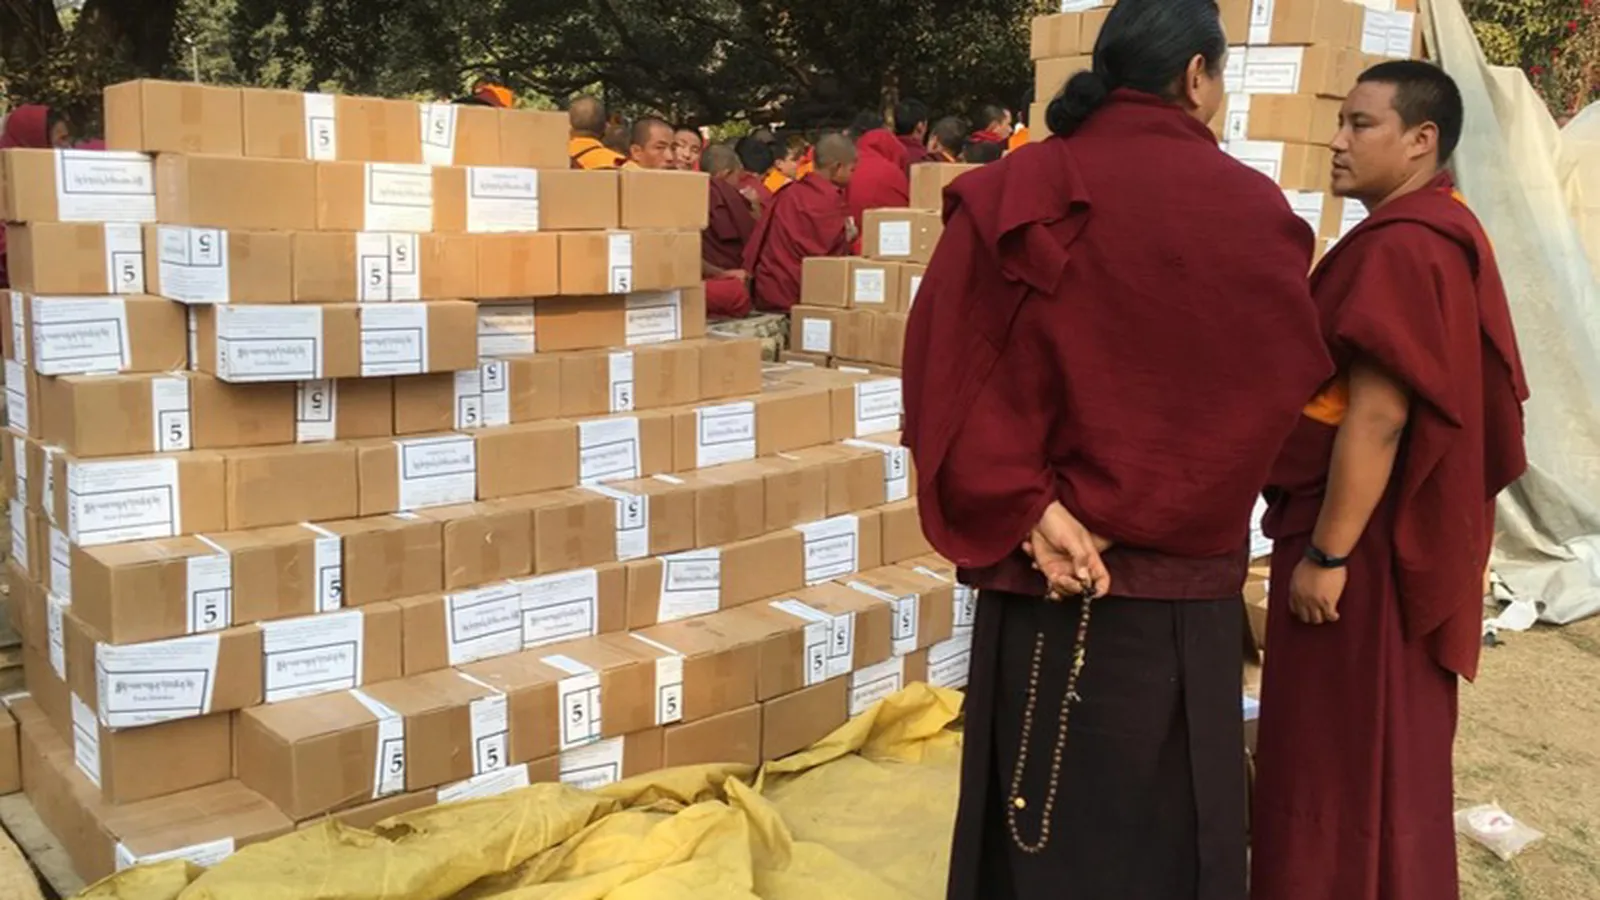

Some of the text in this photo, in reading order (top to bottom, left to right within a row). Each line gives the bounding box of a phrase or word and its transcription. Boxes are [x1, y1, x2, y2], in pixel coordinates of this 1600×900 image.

[435, 119, 445, 135] 5
[319, 130, 330, 145] 5
[198, 234, 211, 253] 5
[396, 246, 406, 262] 5
[123, 265, 136, 282] 5
[371, 269, 382, 285] 5
[618, 277, 628, 292] 5
[488, 365, 497, 380] 5
[311, 391, 324, 409] 5
[619, 391, 629, 406] 5
[466, 407, 476, 423] 5
[169, 424, 182, 442] 5
[628, 503, 637, 519] 5
[329, 579, 342, 598] 5
[204, 604, 217, 623] 5
[902, 615, 910, 631] 5
[836, 630, 846, 646] 5
[813, 654, 823, 671] 5
[572, 704, 583, 722] 5
[667, 696, 677, 714] 5
[390, 753, 403, 773] 5
[486, 748, 498, 767] 5
